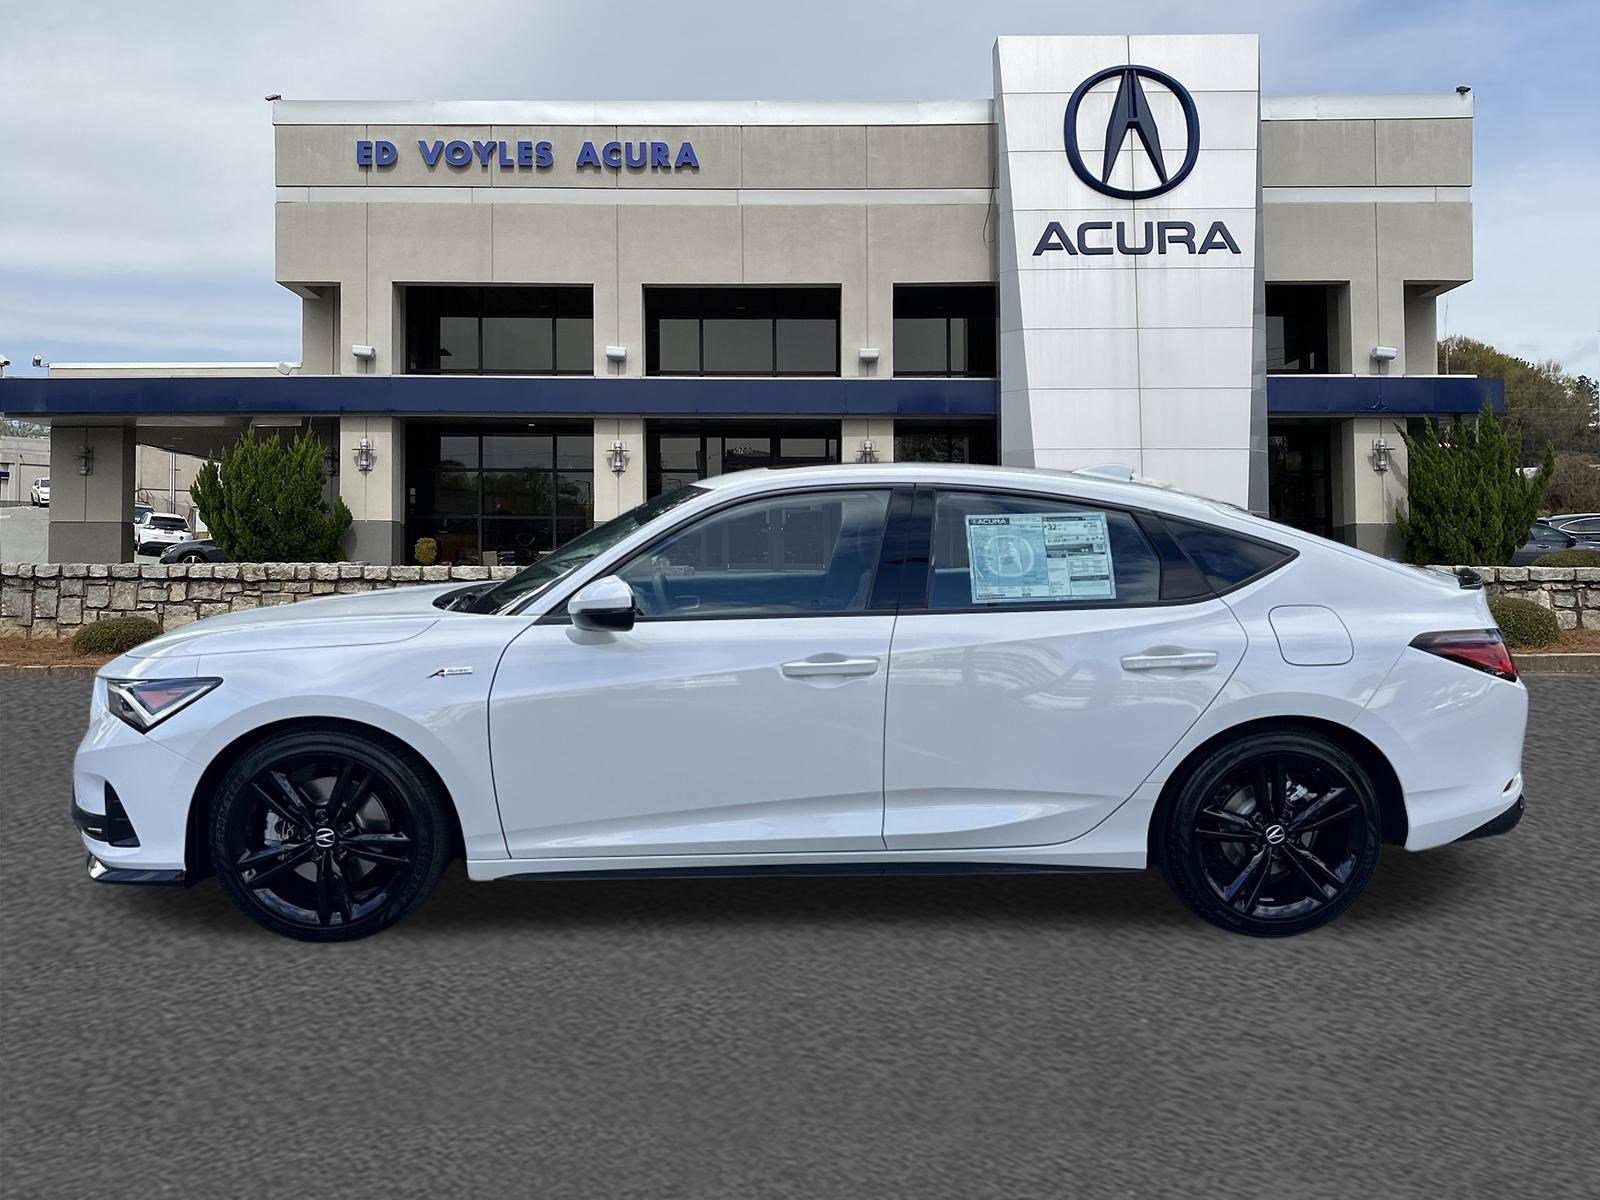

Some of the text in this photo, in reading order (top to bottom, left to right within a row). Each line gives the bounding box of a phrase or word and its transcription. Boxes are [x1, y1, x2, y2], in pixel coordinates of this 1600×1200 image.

[356, 140, 700, 169] ED VOYLES ACURA
[1032, 221, 1242, 256] ACURA
